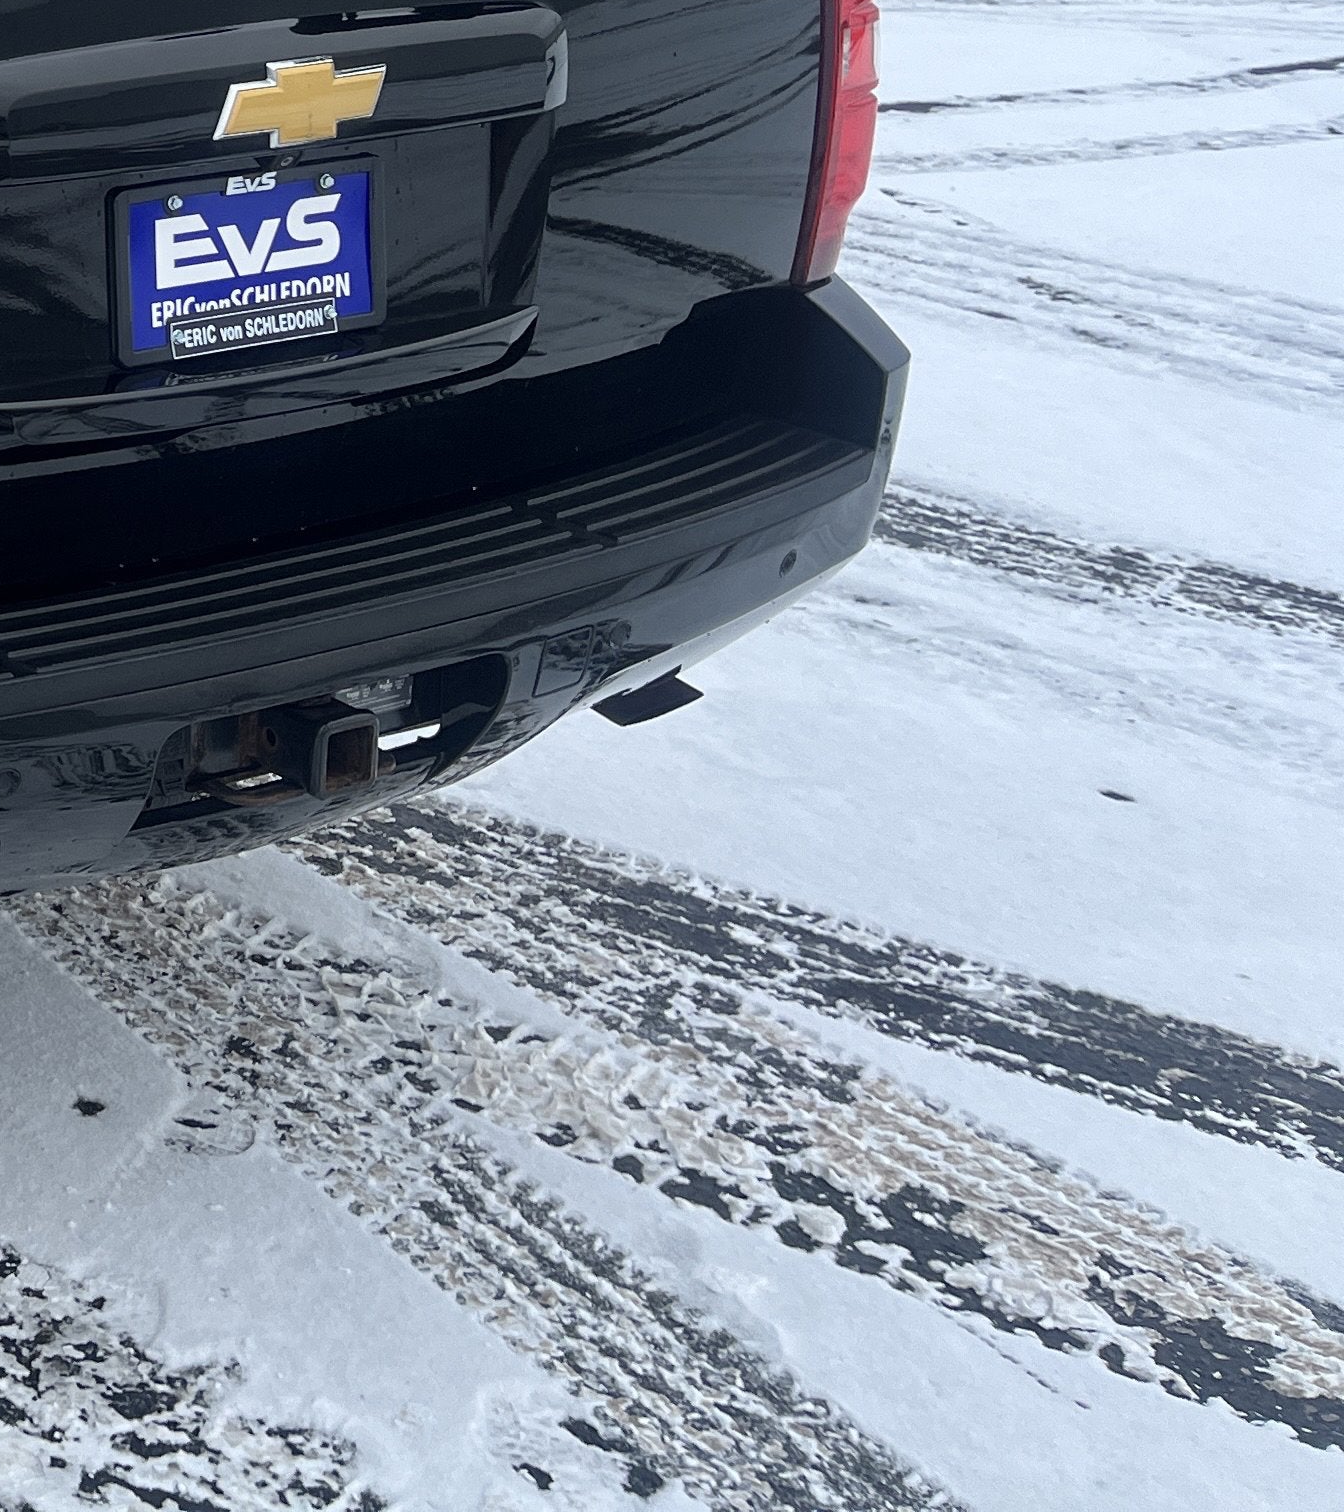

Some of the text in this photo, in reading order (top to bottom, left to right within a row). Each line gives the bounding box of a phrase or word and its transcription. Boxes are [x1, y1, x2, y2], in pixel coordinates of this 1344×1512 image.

[183, 307, 324, 348] ERIC von SCHLEDORN
